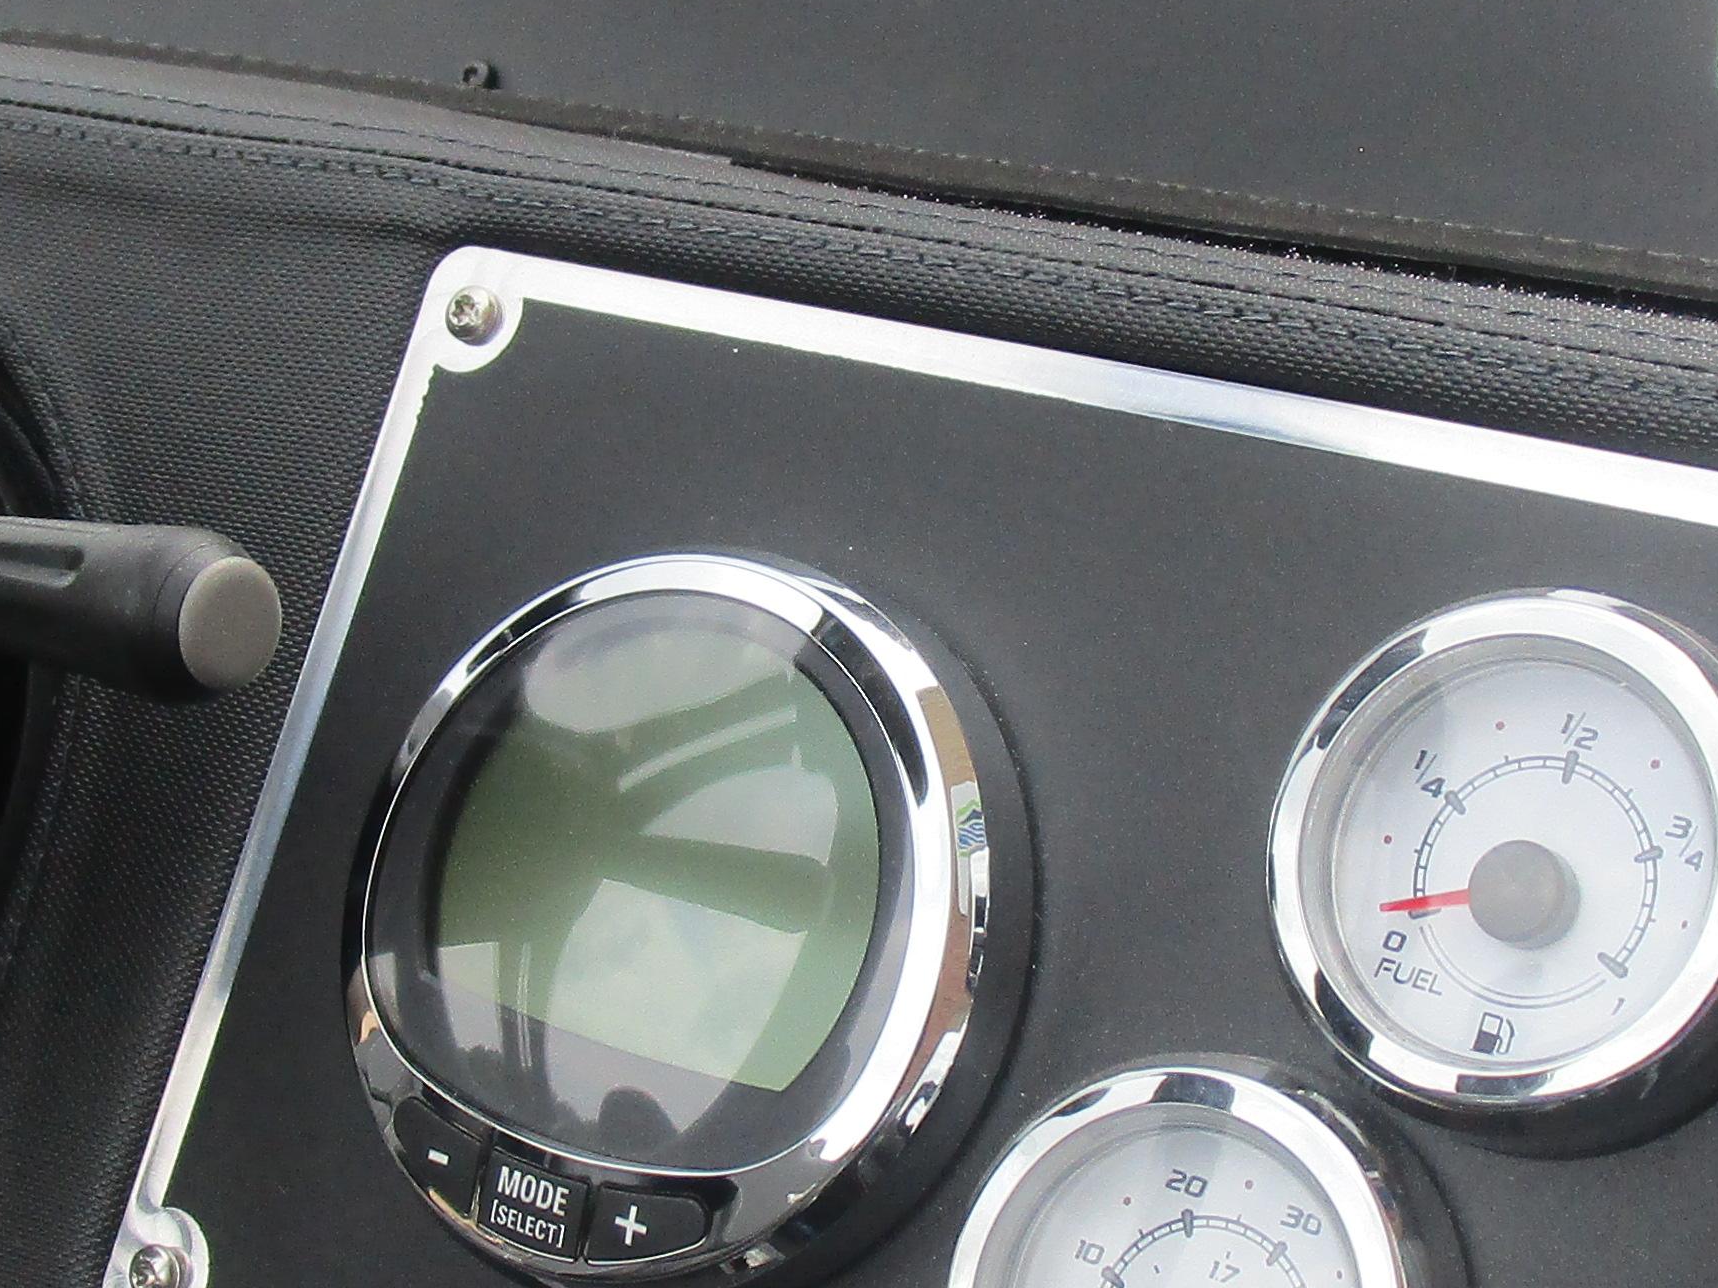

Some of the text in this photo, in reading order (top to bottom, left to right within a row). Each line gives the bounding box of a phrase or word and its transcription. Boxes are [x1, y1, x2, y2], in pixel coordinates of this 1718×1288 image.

[1561, 712, 1599, 751] 1/2
[1414, 749, 1446, 799] 1/4
[1665, 815, 1704, 873] 3/4
[1383, 930, 1408, 953] 0
[1374, 957, 1443, 997] FUEL
[496, 1165, 571, 1217] MODE
[1165, 1168, 1208, 1198] 20
[489, 1198, 566, 1249] [SELECT]
[1279, 1205, 1323, 1236] 30
[1075, 1239, 1105, 1265] 10
